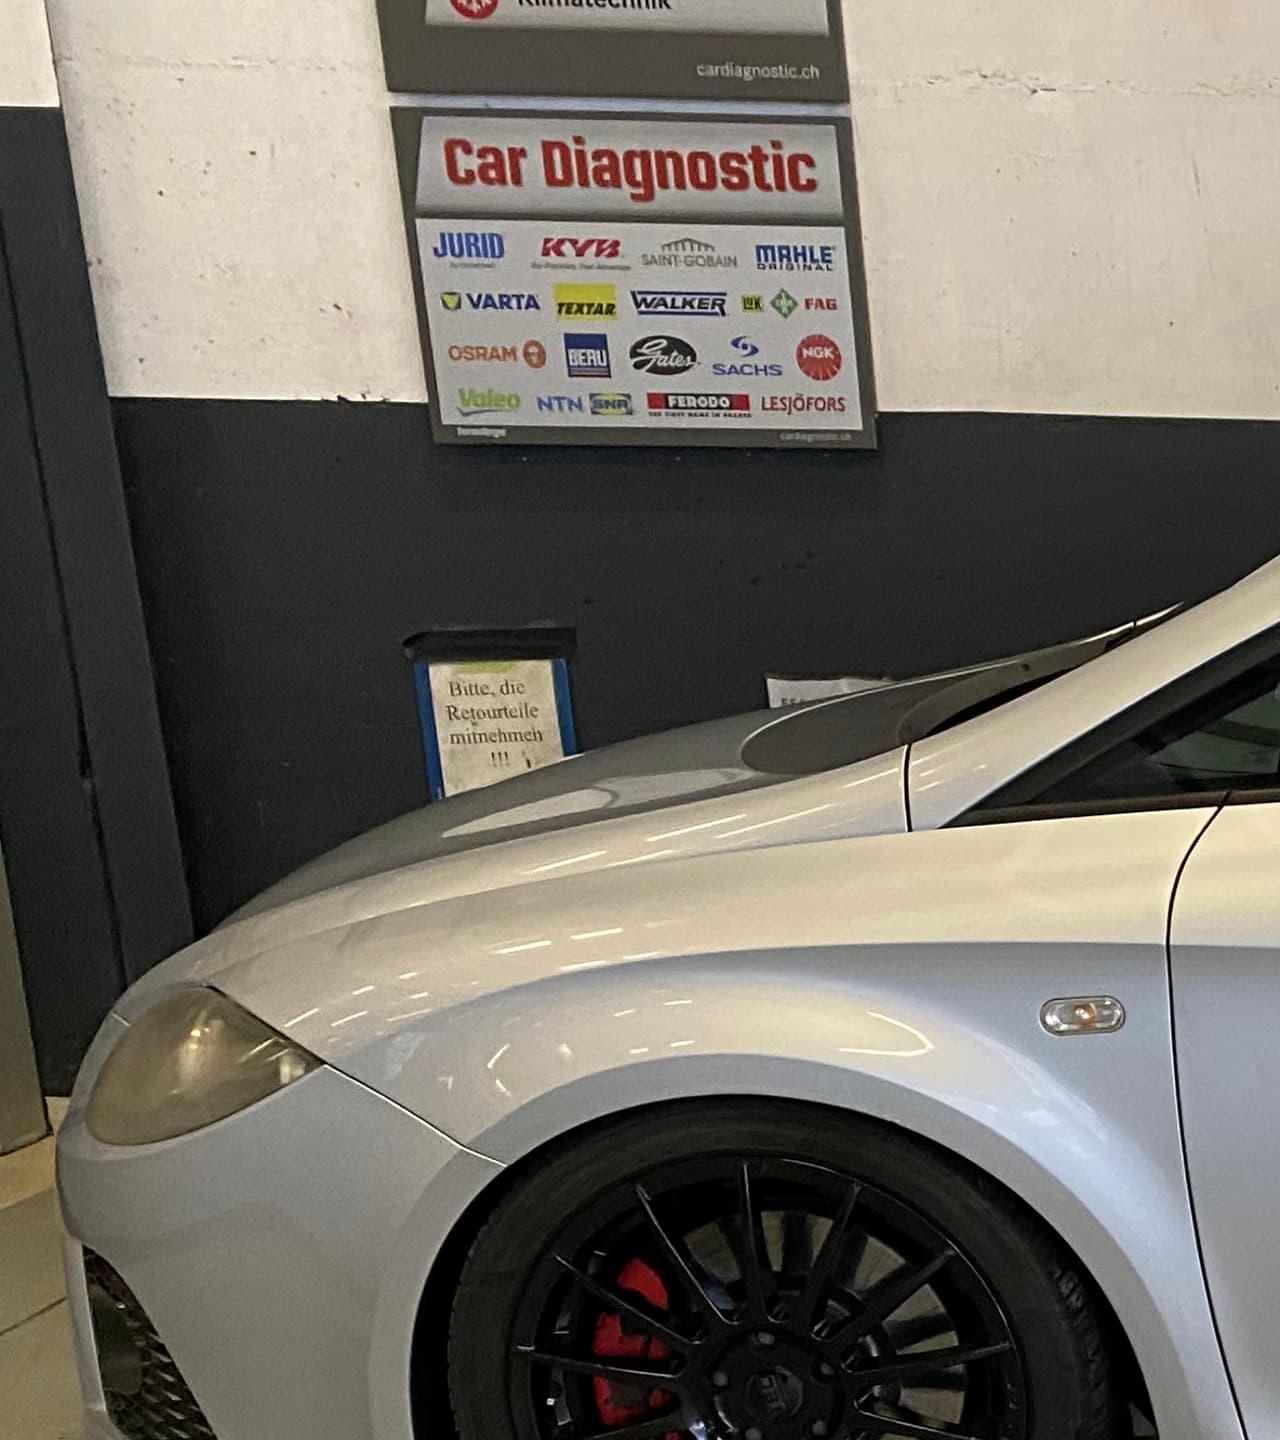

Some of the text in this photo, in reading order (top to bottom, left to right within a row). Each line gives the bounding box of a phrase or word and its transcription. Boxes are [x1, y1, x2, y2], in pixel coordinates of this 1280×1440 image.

[697, 61, 820, 81] cardiagnostic.ch
[443, 135, 818, 202] Car Diagnostic
[433, 232, 505, 258] JURID
[541, 237, 621, 258] KYB
[755, 244, 833, 263] MAHLE
[641, 253, 738, 268] SAINT-GOBAIN
[757, 263, 834, 271] ORIGINAL
[466, 293, 540, 310] VARTA
[557, 302, 616, 316] TEXTAR
[631, 291, 727, 316] WALKER
[804, 298, 838, 311] FAG
[448, 345, 517, 362] OSRAM
[632, 339, 697, 371] Gates
[802, 347, 835, 360] NGK
[712, 363, 783, 376] SACHS
[458, 388, 521, 409] Valeo
[536, 396, 583, 412] NTN
[667, 395, 731, 408] FERODO
[761, 393, 846, 415] LESJÖFORS
[448, 679, 525, 697] Bitte, die
[446, 702, 539, 720] Retourteile
[449, 727, 544, 744] mitnehmen
